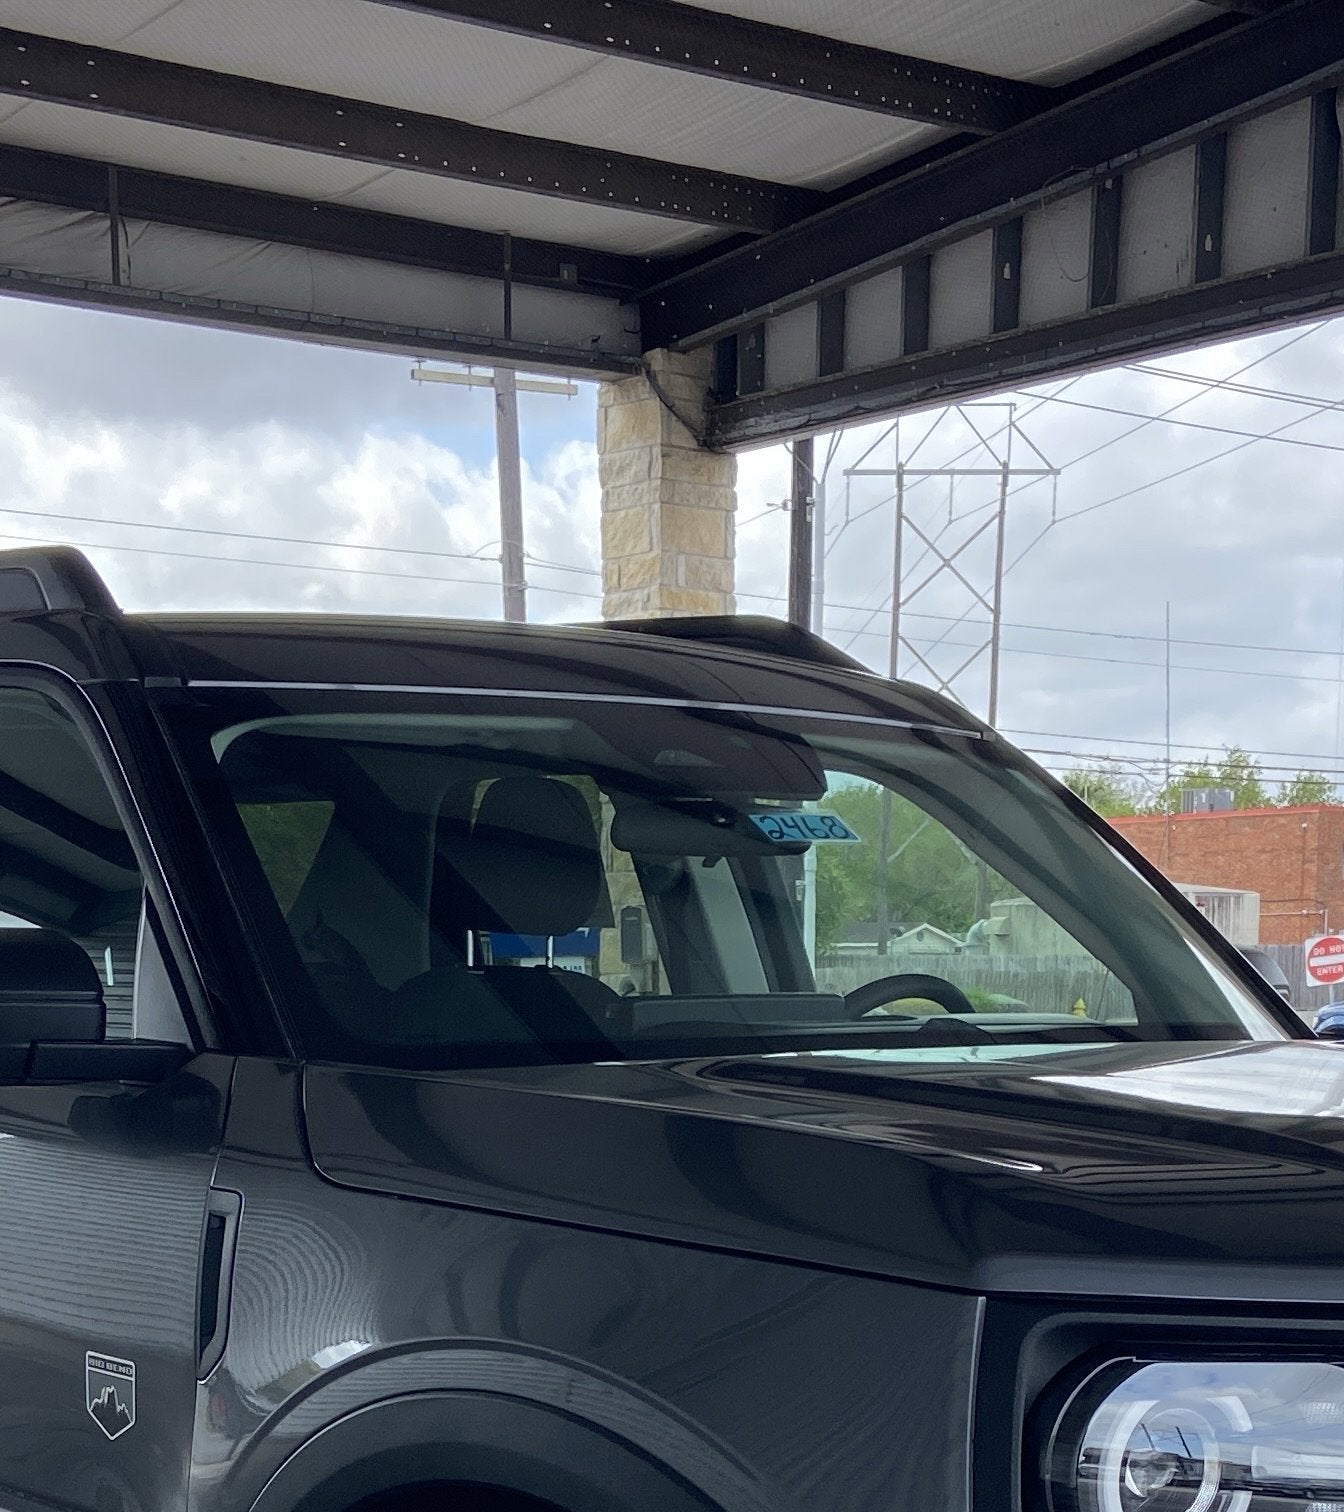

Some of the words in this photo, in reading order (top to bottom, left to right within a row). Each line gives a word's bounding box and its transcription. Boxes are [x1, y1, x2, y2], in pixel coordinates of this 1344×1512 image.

[759, 815, 850, 840] 2468
[1313, 946, 1326, 956] DO
[1316, 965, 1344, 976] ENTER
[89, 1358, 105, 1368] BIG
[106, 1363, 132, 1375] BEND
